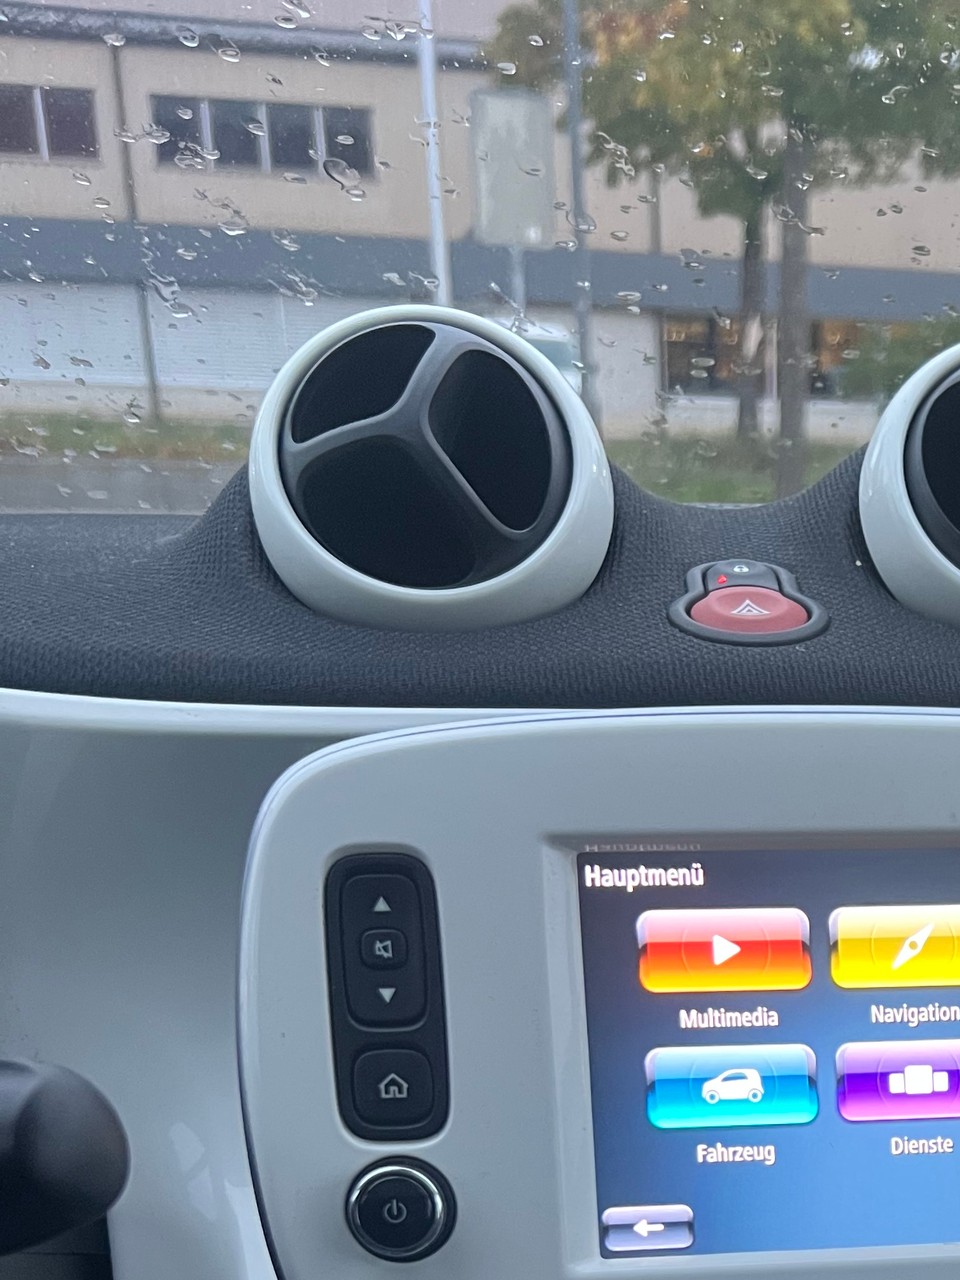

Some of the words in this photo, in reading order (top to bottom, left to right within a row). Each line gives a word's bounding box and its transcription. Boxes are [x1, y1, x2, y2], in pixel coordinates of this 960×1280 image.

[584, 863, 704, 893] Hauptmenü
[679, 1007, 779, 1029] Multimedia
[871, 1004, 960, 1027] Navigation
[696, 1142, 776, 1166] Fahrzeug
[891, 1135, 954, 1155] Dienste
